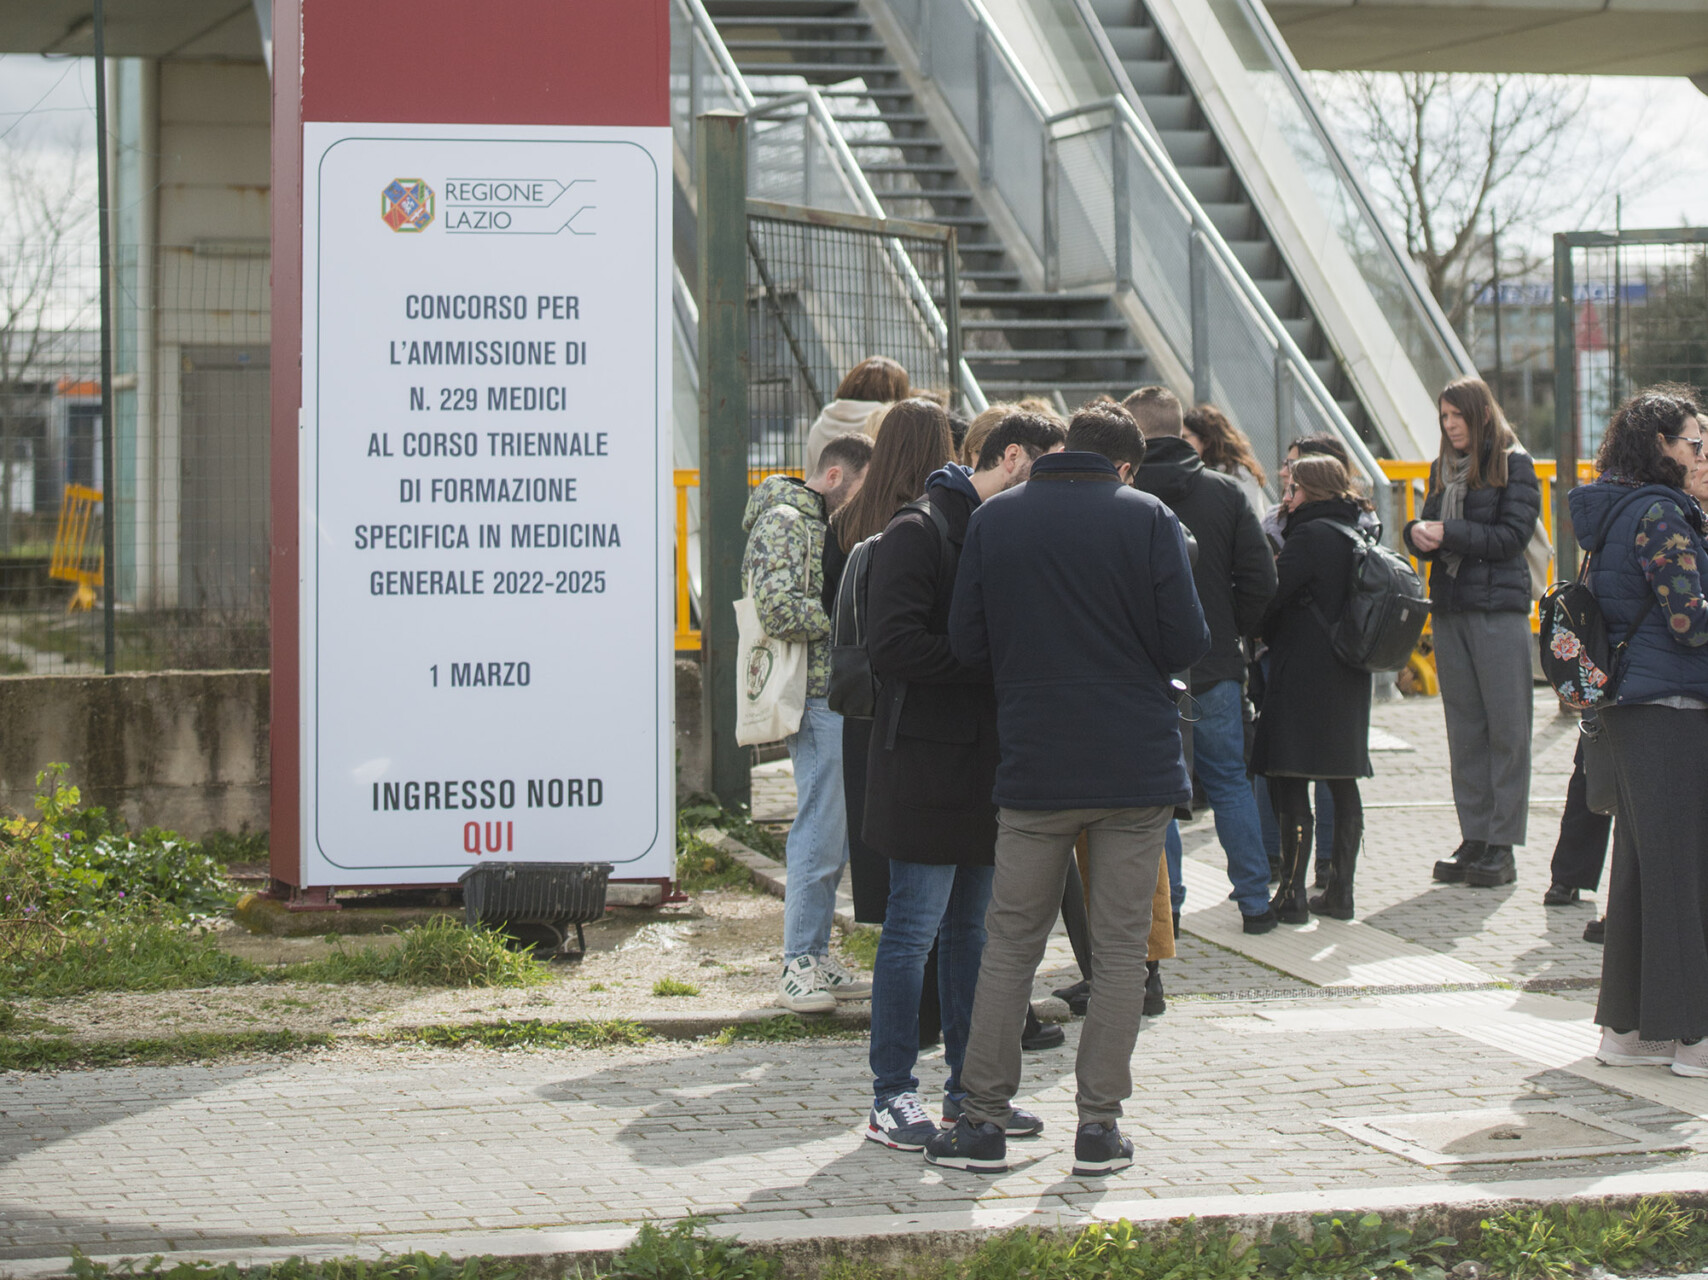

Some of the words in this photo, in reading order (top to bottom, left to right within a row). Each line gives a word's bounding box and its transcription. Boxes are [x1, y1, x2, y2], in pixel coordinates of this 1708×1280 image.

[445, 183, 544, 202] REGIONE
[445, 211, 512, 229] LAZIO
[407, 295, 526, 319] CONCORSO
[538, 296, 579, 319] PER
[391, 341, 555, 365] L'AMMISSIONE
[566, 342, 585, 365] DI
[411, 387, 430, 410] N.
[440, 388, 477, 410] 229
[488, 387, 565, 411] MEDICI
[368, 433, 393, 456] AL
[404, 433, 477, 457] CORSO
[487, 433, 608, 456] TRIENNALE
[401, 479, 420, 502] DI
[432, 478, 576, 502] FORMAZIONE
[355, 524, 469, 549] SPECIFICA
[480, 525, 500, 548] IN
[512, 524, 620, 548] MEDICINA
[371, 571, 484, 595] GENERALE
[494, 571, 605, 594] 2022-2025
[430, 665, 437, 687] 1
[452, 662, 530, 686] MARZO
[373, 780, 514, 811] INGRESSO
[528, 779, 602, 807] NORD
[464, 821, 512, 855] QUI
